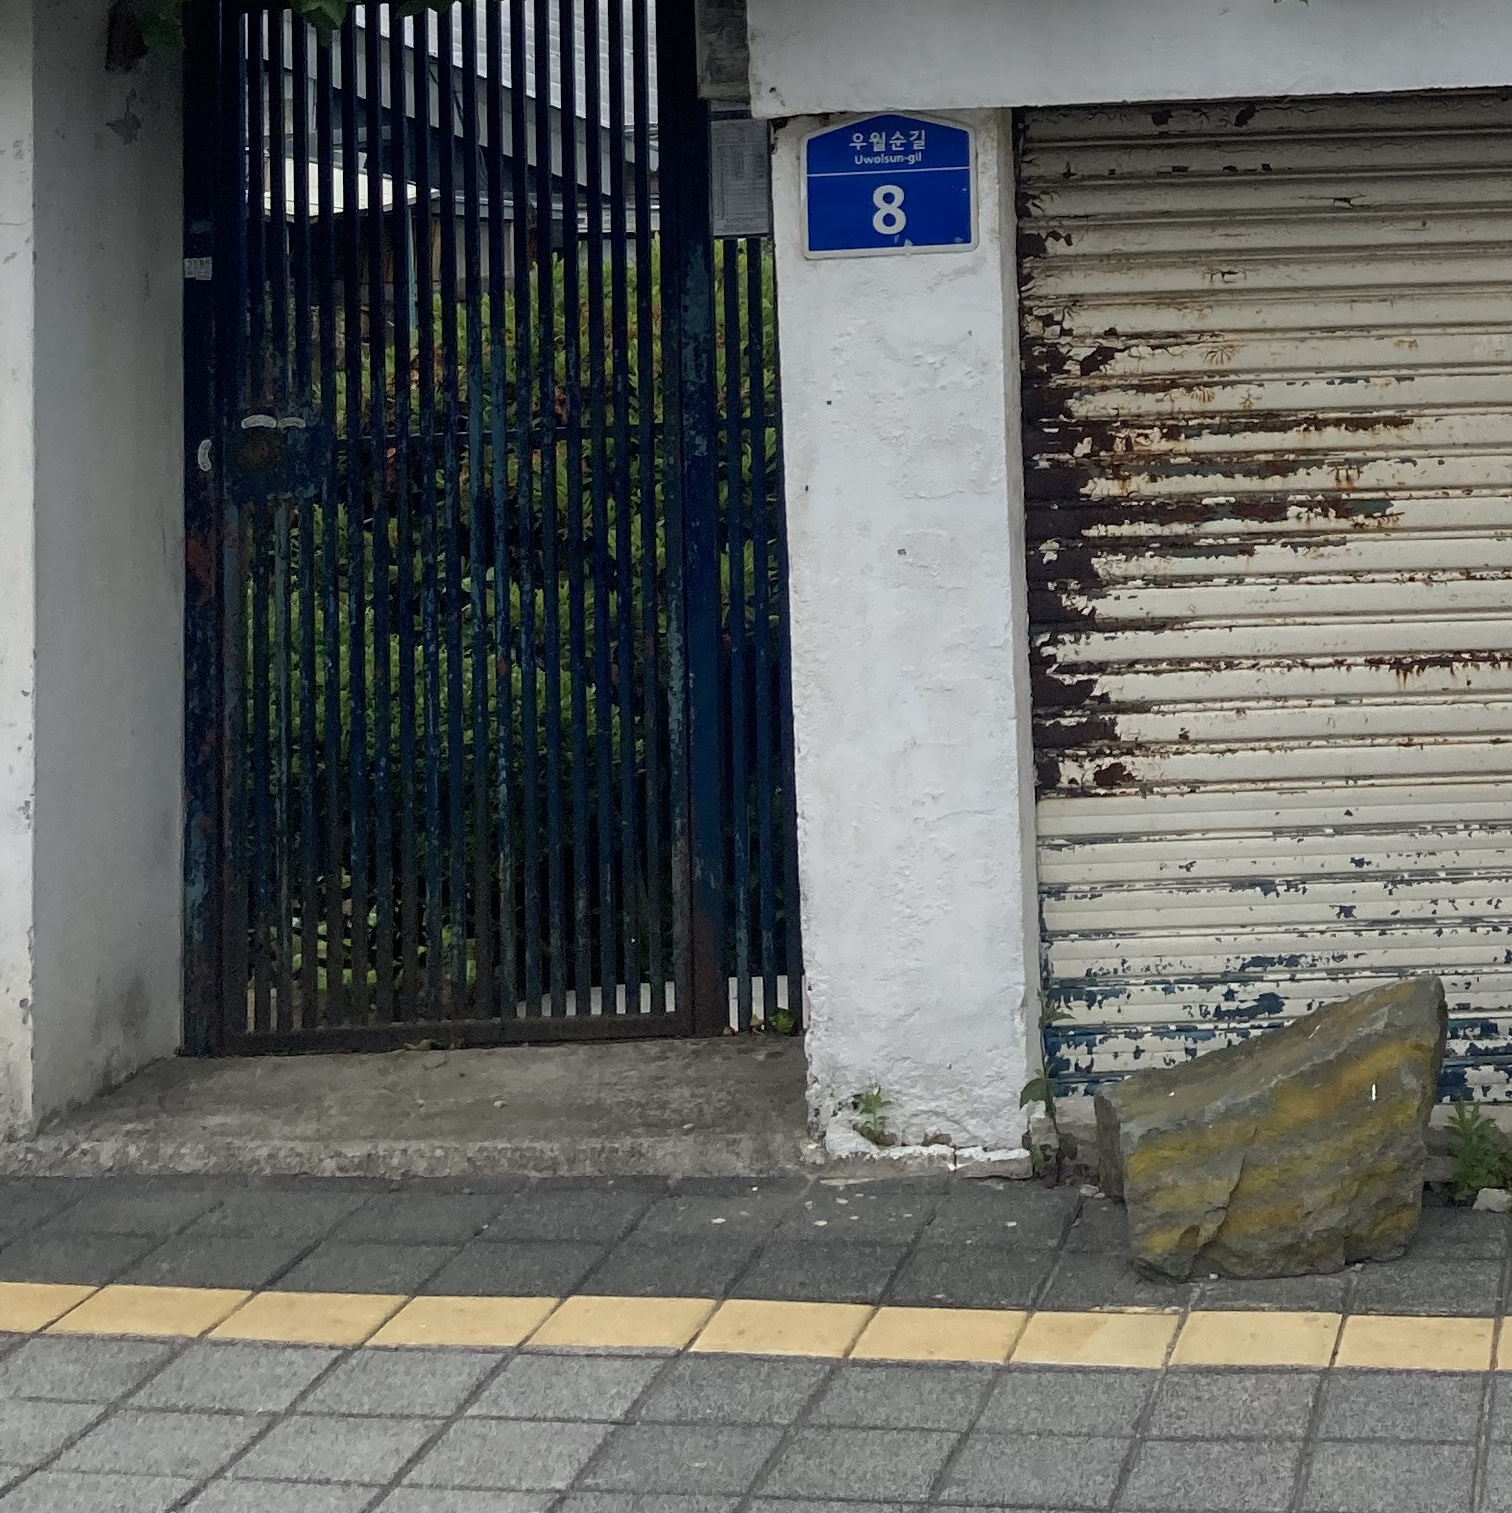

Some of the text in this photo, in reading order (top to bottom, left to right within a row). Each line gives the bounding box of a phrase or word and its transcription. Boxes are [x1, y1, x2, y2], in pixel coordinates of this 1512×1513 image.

[850, 130, 925, 151] 우월순길
[854, 152, 922, 165] Uwolsun-gil
[872, 184, 907, 235] 8
